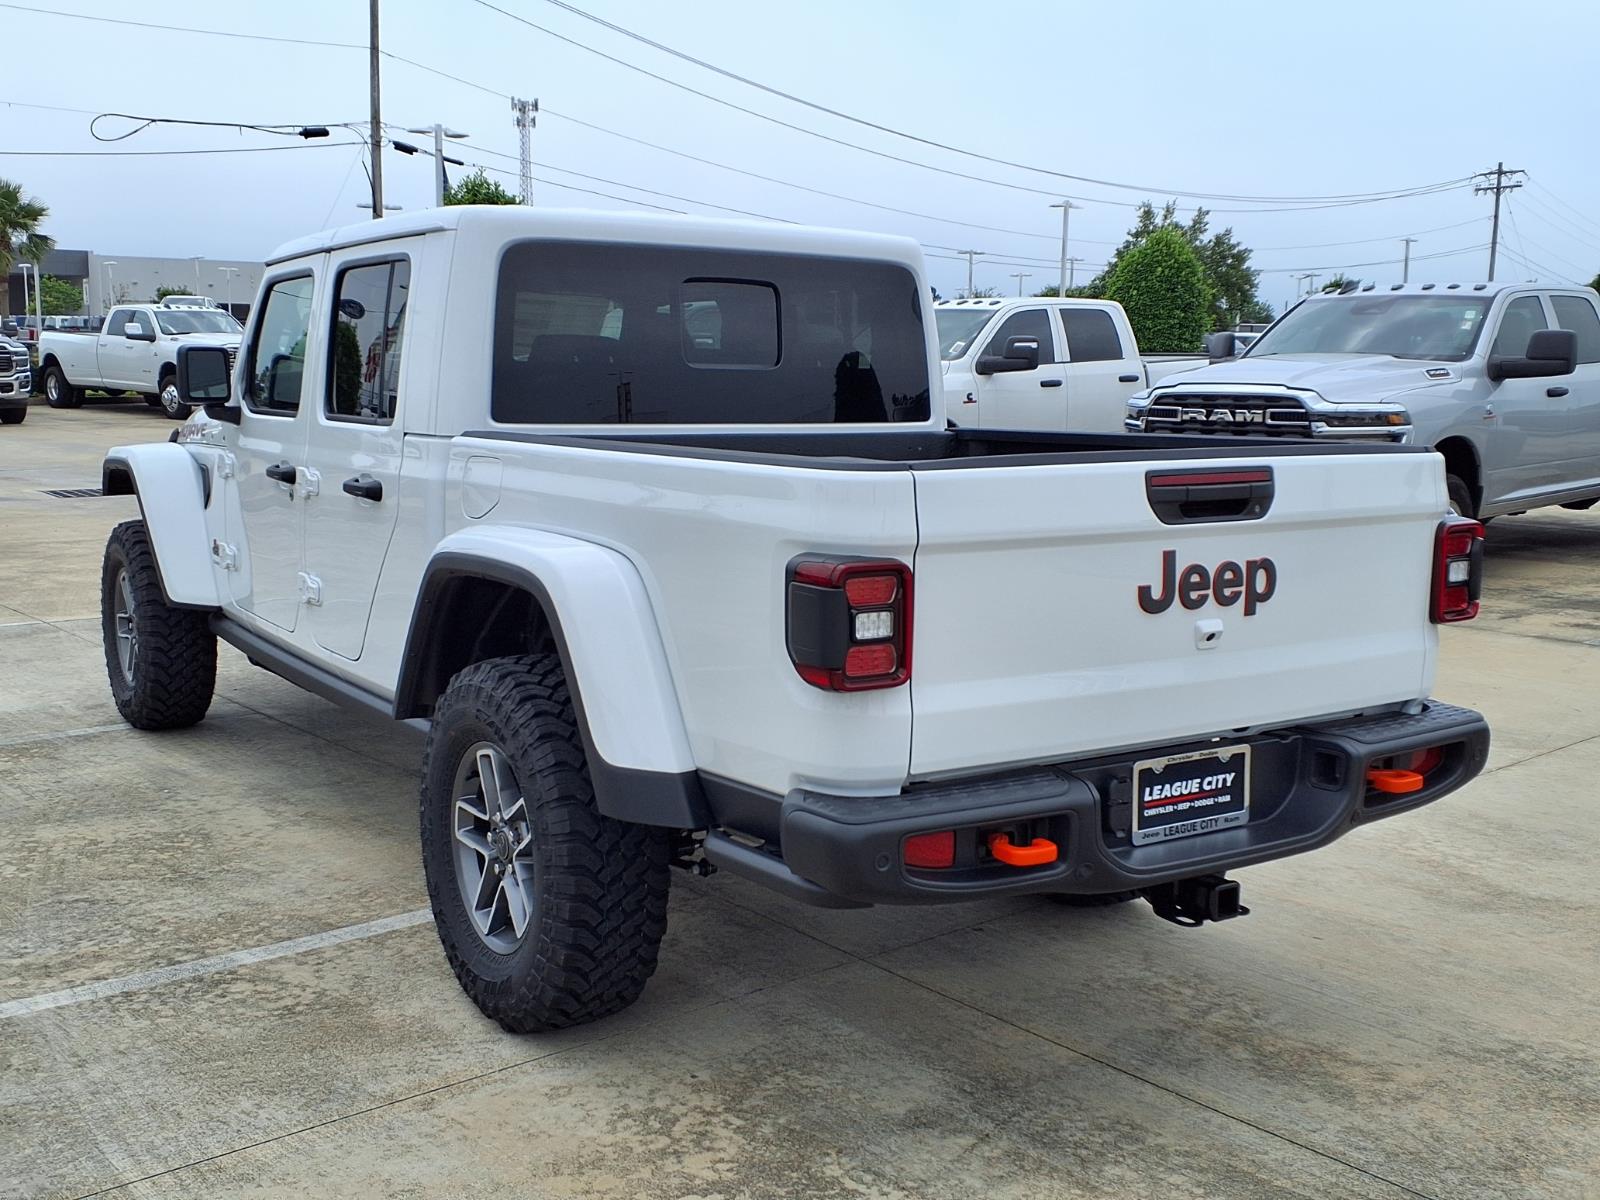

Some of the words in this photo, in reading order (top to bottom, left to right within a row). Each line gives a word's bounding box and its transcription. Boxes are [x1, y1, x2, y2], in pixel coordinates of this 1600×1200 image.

[1182, 408, 1264, 423] RAM
[1137, 549, 1277, 617] Jeep
[1144, 778, 1202, 802] LEAGUE
[1202, 772, 1236, 790] CITY
[1143, 805, 1174, 817] CHRYSLER
[1177, 801, 1191, 811] JEEP
[1194, 798, 1214, 808] DODGE
[1217, 795, 1231, 803] RAM
[1163, 821, 1198, 837] LEAGUE
[1200, 818, 1220, 830] CITY
